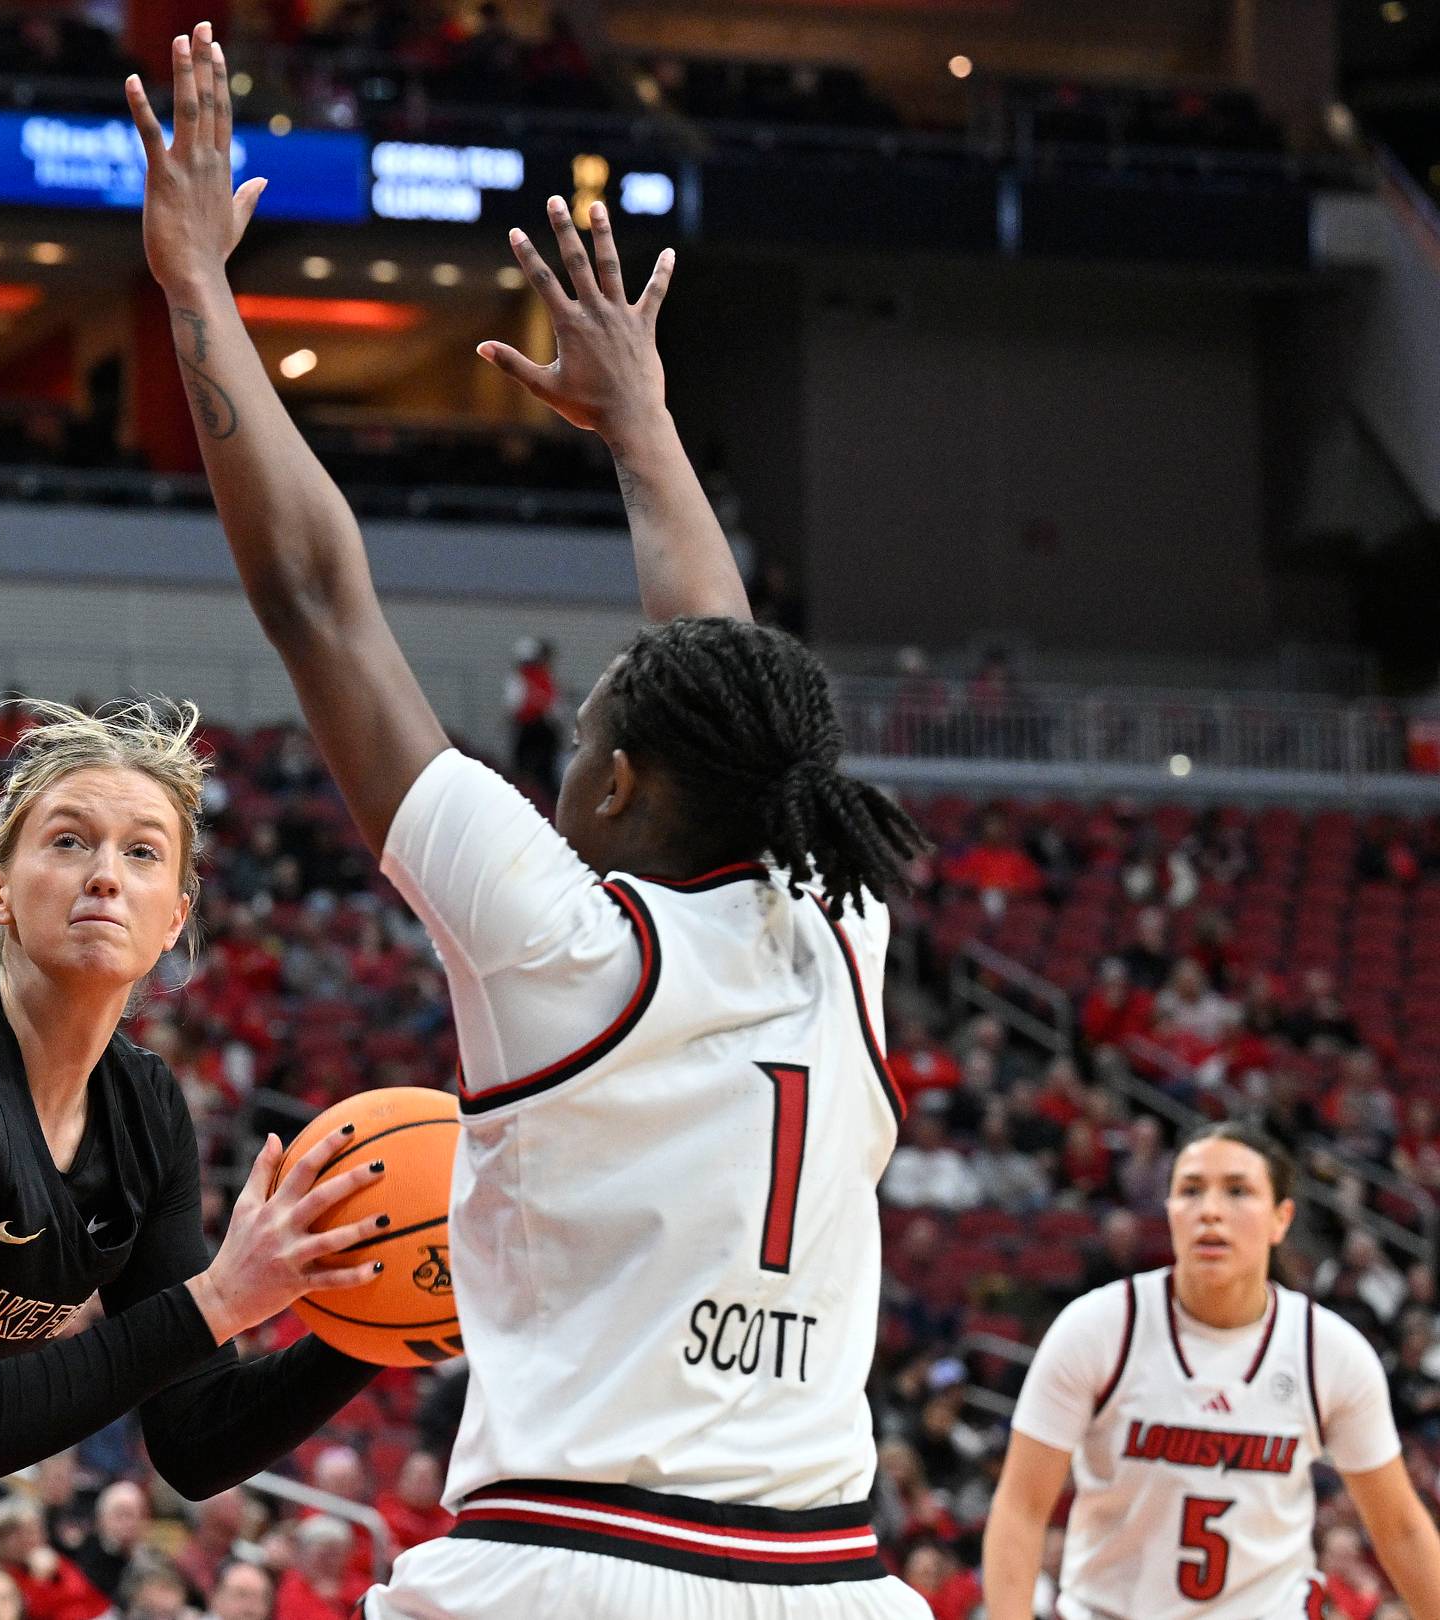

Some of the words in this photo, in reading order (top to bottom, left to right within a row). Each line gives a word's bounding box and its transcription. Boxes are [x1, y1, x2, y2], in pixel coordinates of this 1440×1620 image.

[752, 1060, 810, 1274] 1
[684, 1298, 817, 1382] SCOTT
[1122, 1419, 1299, 1477] LOUISVILLE
[1177, 1494, 1237, 1602] 5
